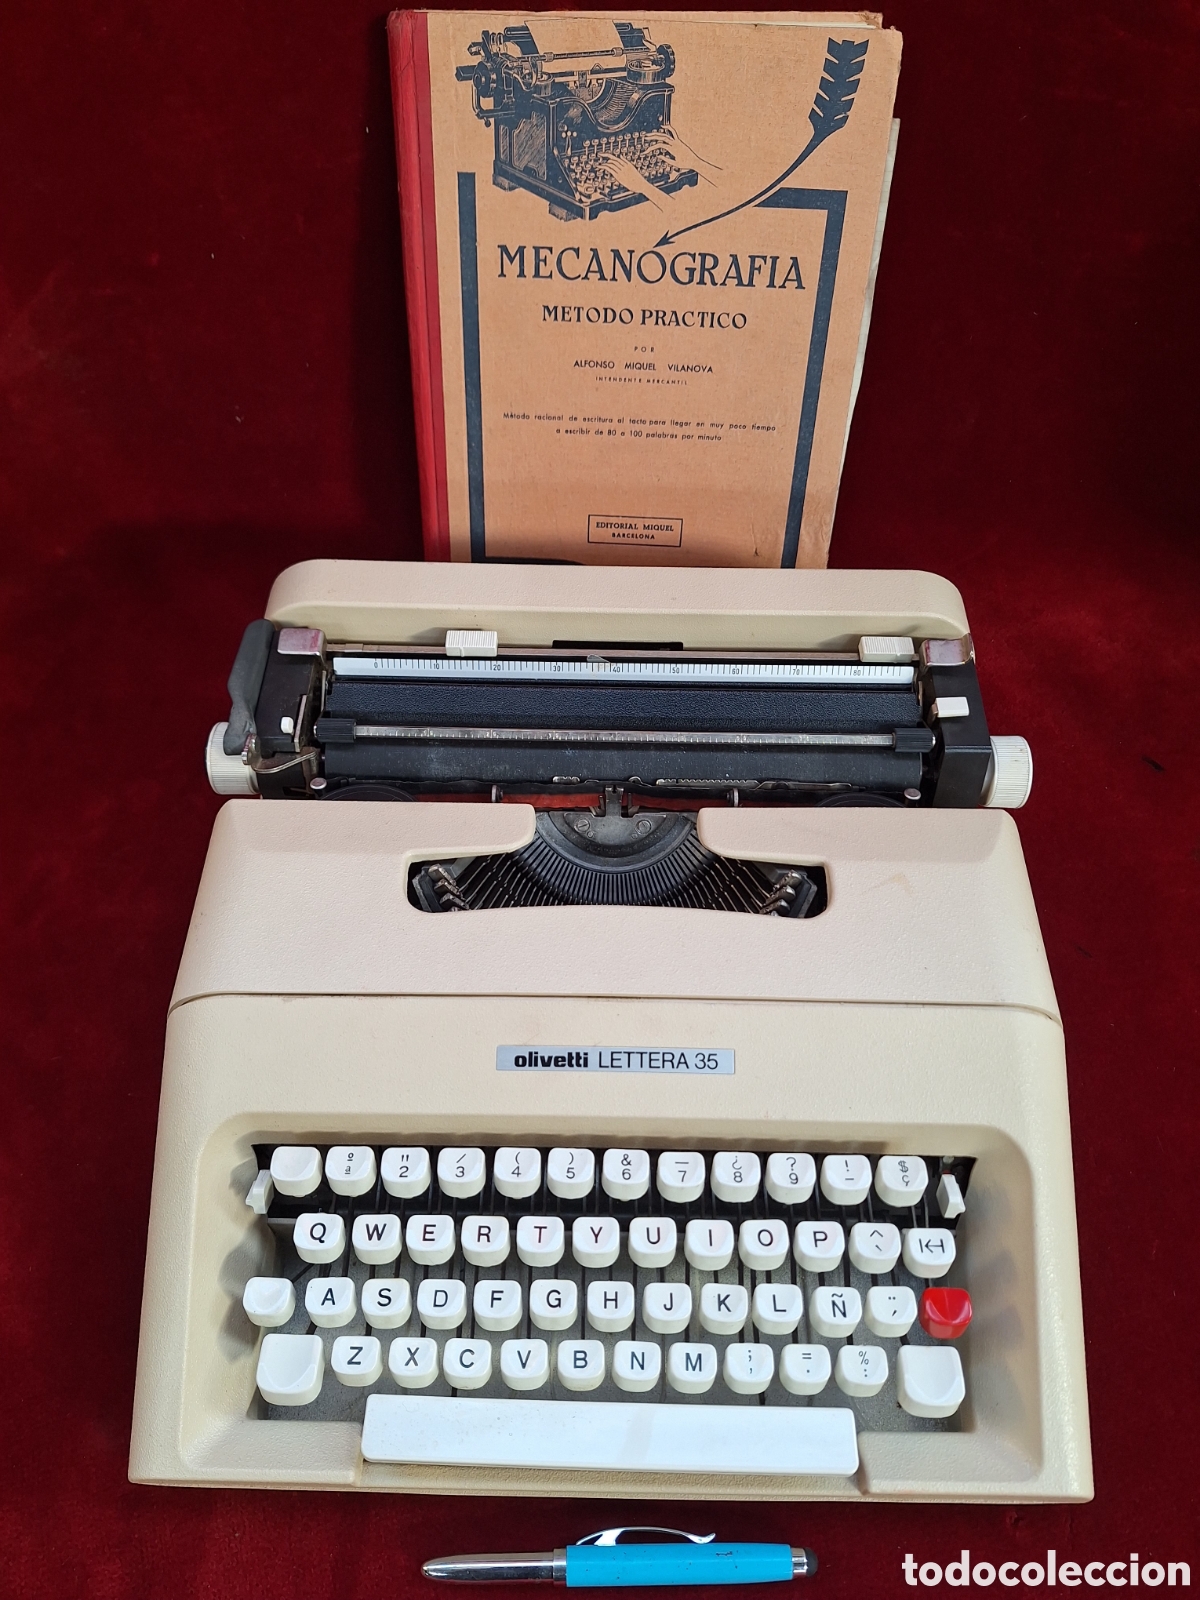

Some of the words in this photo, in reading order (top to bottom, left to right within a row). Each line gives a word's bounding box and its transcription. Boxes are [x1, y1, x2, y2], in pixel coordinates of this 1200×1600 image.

[498, 244, 806, 290] MECANOGRAFIA
[542, 304, 634, 325] METODO
[640, 309, 747, 329] PRACTICO
[573, 360, 615, 369] ALFONSO
[624, 362, 656, 371] MIQUEL
[667, 363, 713, 373] VILANOVA
[534, 413, 564, 421] racional
[582, 415, 613, 424] escritura
[649, 420, 666, 429] para
[670, 419, 692, 428] llegar
[709, 422, 724, 430] muy
[751, 423, 776, 432] tiempo
[607, 429, 617, 437] 80
[629, 430, 643, 438] 100
[645, 431, 678, 440] palabras
[681, 433, 694, 441] por
[697, 433, 722, 441] minuto
[595, 521, 639, 530] EDITORIAL
[643, 524, 674, 532] MIQUEL
[611, 532, 655, 540] BARCELONA
[493, 663, 501, 671] 20
[552, 664, 561, 672] 30
[672, 666, 680, 674] 50
[792, 668, 800, 676] 70
[853, 669, 861, 677] 80
[514, 1051, 589, 1068] olivetti
[598, 1051, 690, 1070] LETTERA
[694, 1053, 719, 1070] 35
[399, 1166, 408, 1177] 2
[456, 1166, 464, 1177] 3
[512, 1166, 521, 1177] 4
[567, 1167, 575, 1179] 5
[622, 1169, 631, 1180] 6
[678, 1171, 686, 1182] 7
[733, 1171, 743, 1183] 8
[788, 1173, 799, 1185] 9
[310, 1223, 326, 1243] Q
[366, 1224, 386, 1241] W
[423, 1224, 436, 1241] E
[478, 1226, 491, 1242] R
[534, 1226, 547, 1243] T
[590, 1227, 602, 1243] Y
[647, 1227, 660, 1244] U
[758, 1229, 773, 1246] O
[813, 1231, 827, 1247] P
[321, 1288, 335, 1305] A
[377, 1288, 391, 1306] S
[434, 1290, 448, 1307] D
[491, 1291, 504, 1308] F
[547, 1290, 561, 1308] G
[604, 1291, 617, 1309] H
[664, 1293, 673, 1311] J
[718, 1294, 731, 1312] K
[773, 1295, 786, 1312] L
[832, 1294, 846, 1317] Ñ
[347, 1347, 363, 1365] Z
[405, 1348, 419, 1366] X
[460, 1349, 474, 1368] C
[517, 1350, 531, 1369] V
[574, 1351, 587, 1368] B
[631, 1352, 644, 1370] N
[686, 1353, 701, 1372] M
